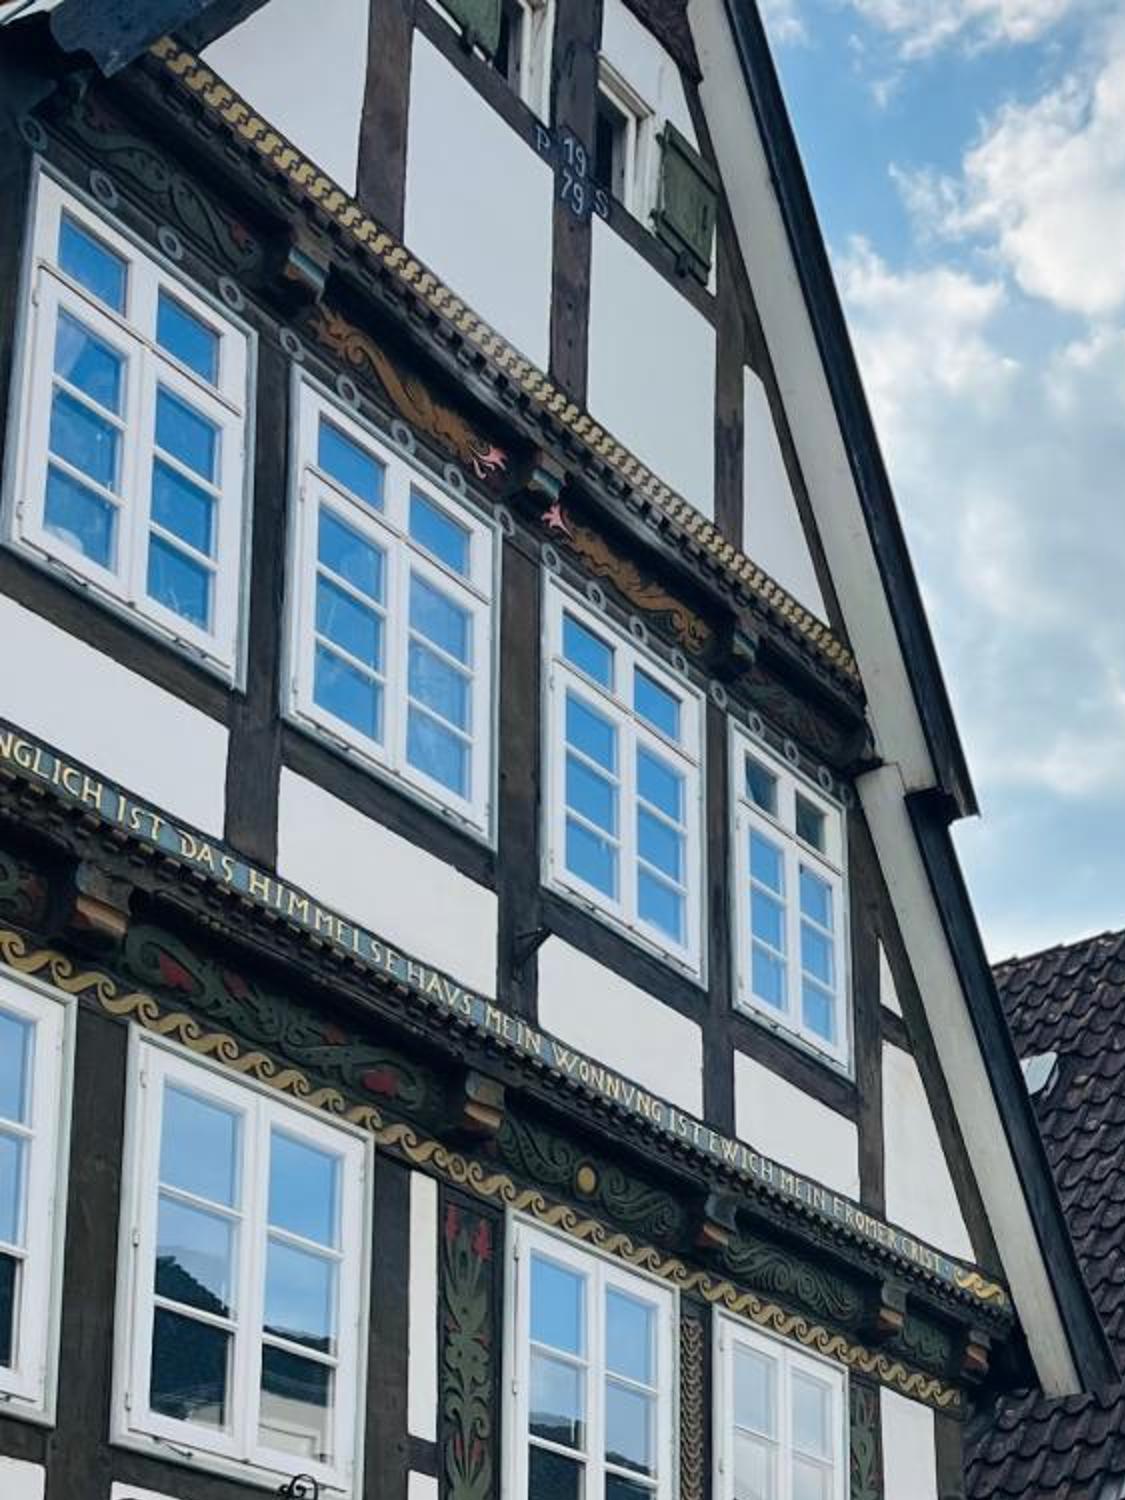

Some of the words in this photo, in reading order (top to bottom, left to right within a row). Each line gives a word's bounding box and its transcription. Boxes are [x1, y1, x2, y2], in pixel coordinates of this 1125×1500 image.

[562, 136, 587, 178] 19
[560, 168, 585, 215] 79
[117, 794, 166, 840] IST
[177, 828, 236, 883] DAS
[484, 1002, 542, 1058] MEIN
[669, 1114, 705, 1147] IST
[780, 1167, 826, 1211] MEIN
